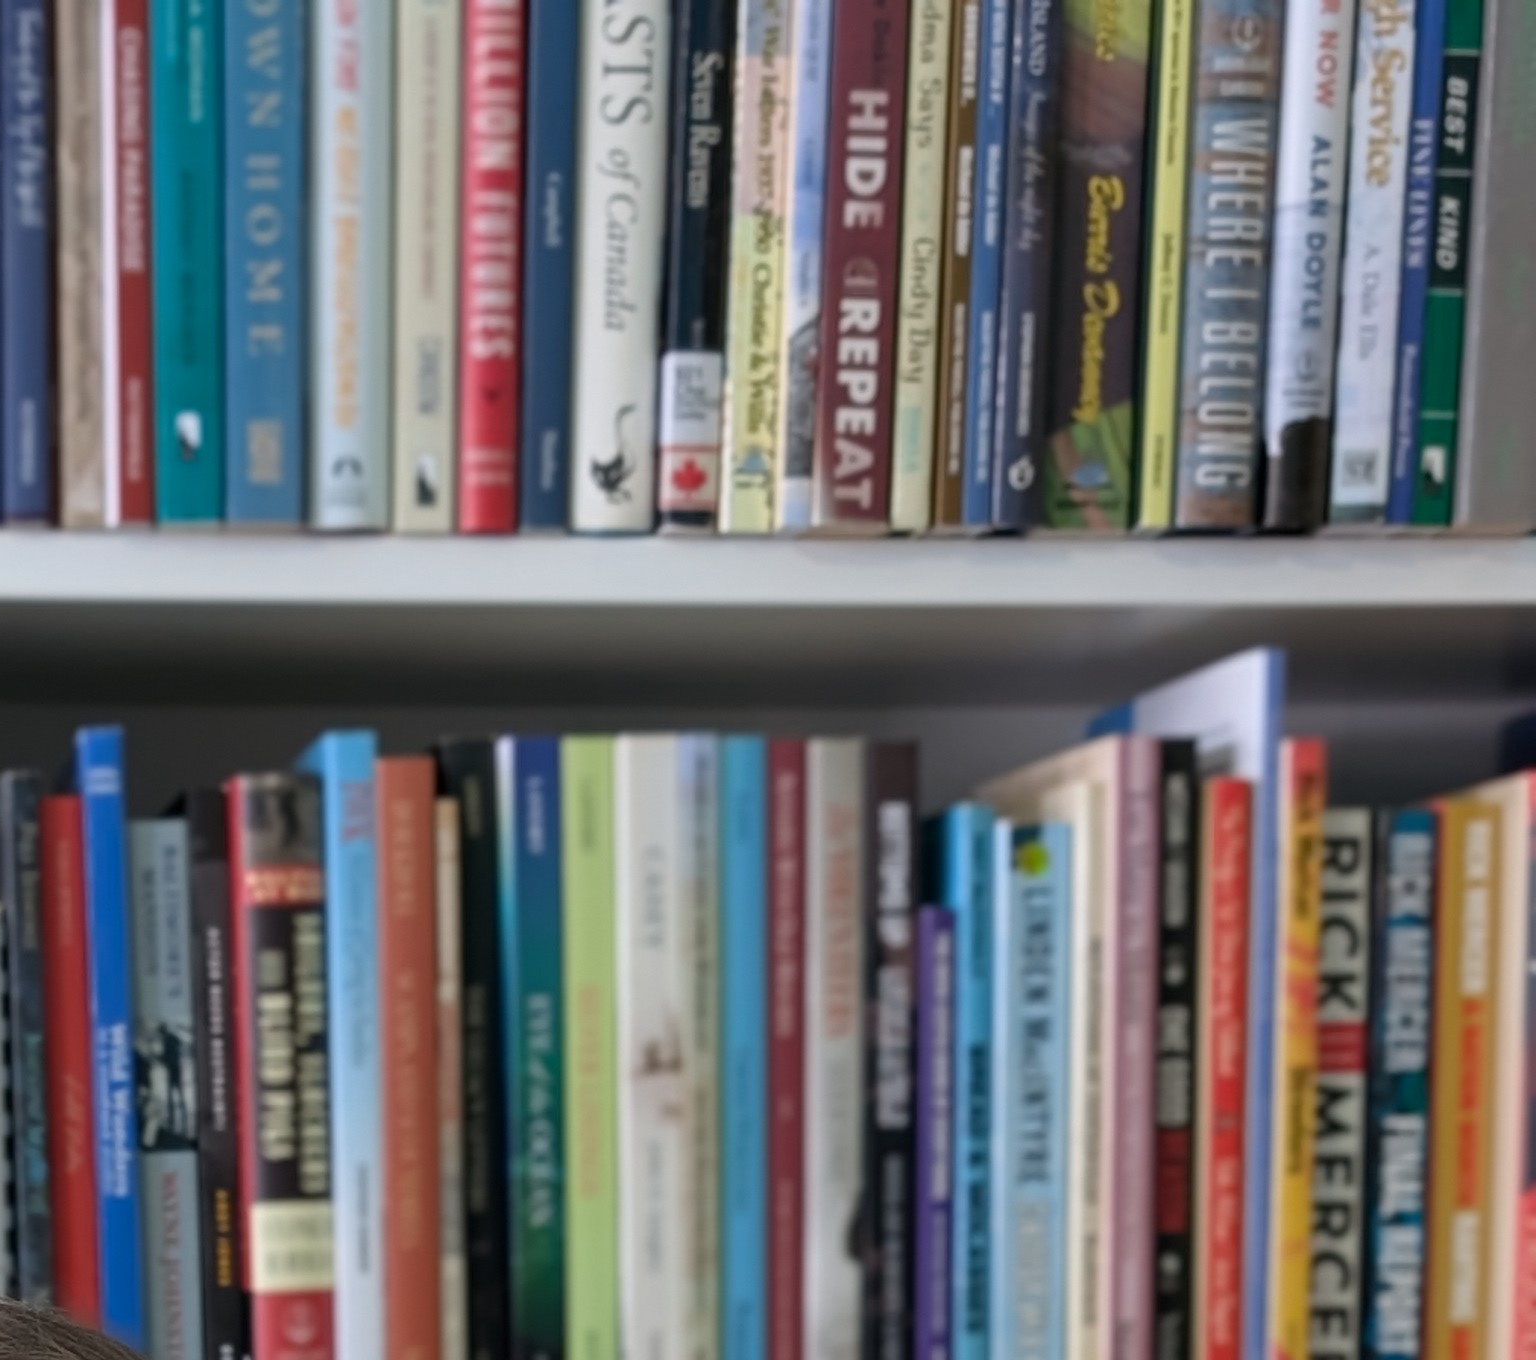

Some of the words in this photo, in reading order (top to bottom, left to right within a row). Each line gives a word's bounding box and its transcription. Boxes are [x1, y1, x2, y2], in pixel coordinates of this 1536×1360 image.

[600, 0, 655, 126] STS
[689, 51, 723, 120] Seven
[1315, 31, 1339, 108] NOW
[843, 89, 889, 227] HIDE
[911, 78, 948, 148] Says
[1366, 50, 1407, 187] Service
[1411, 118, 1433, 184] FINE
[1445, 76, 1469, 153] BEST
[598, 149, 638, 183] of
[688, 125, 720, 208] Ravens
[1206, 118, 1270, 267] WHERE
[1307, 136, 1332, 219] ALAN
[245, 154, 283, 357] HOME
[602, 193, 639, 331] Canada
[1086, 176, 1123, 272] Burris
[1408, 192, 1430, 268] LINES
[1437, 196, 1461, 270] KIND
[469, 191, 516, 358] FUTURES
[753, 263, 775, 345] Christie
[907, 237, 936, 319] Cindy
[1206, 287, 1258, 298] I
[1301, 232, 1327, 331] DOYLE
[902, 328, 935, 383] Day
[833, 298, 881, 509] REPEAT
[1196, 321, 1260, 488] BELONG
[1390, 833, 1431, 919] RICK
[1018, 885, 1052, 1001] LINDEN
[1314, 835, 1360, 1014] RICK
[1385, 925, 1429, 1073] MERCER
[110, 1022, 130, 1082] Wild
[1380, 1114, 1423, 1216] FINAL
[1376, 1226, 1420, 1357] REPORT
